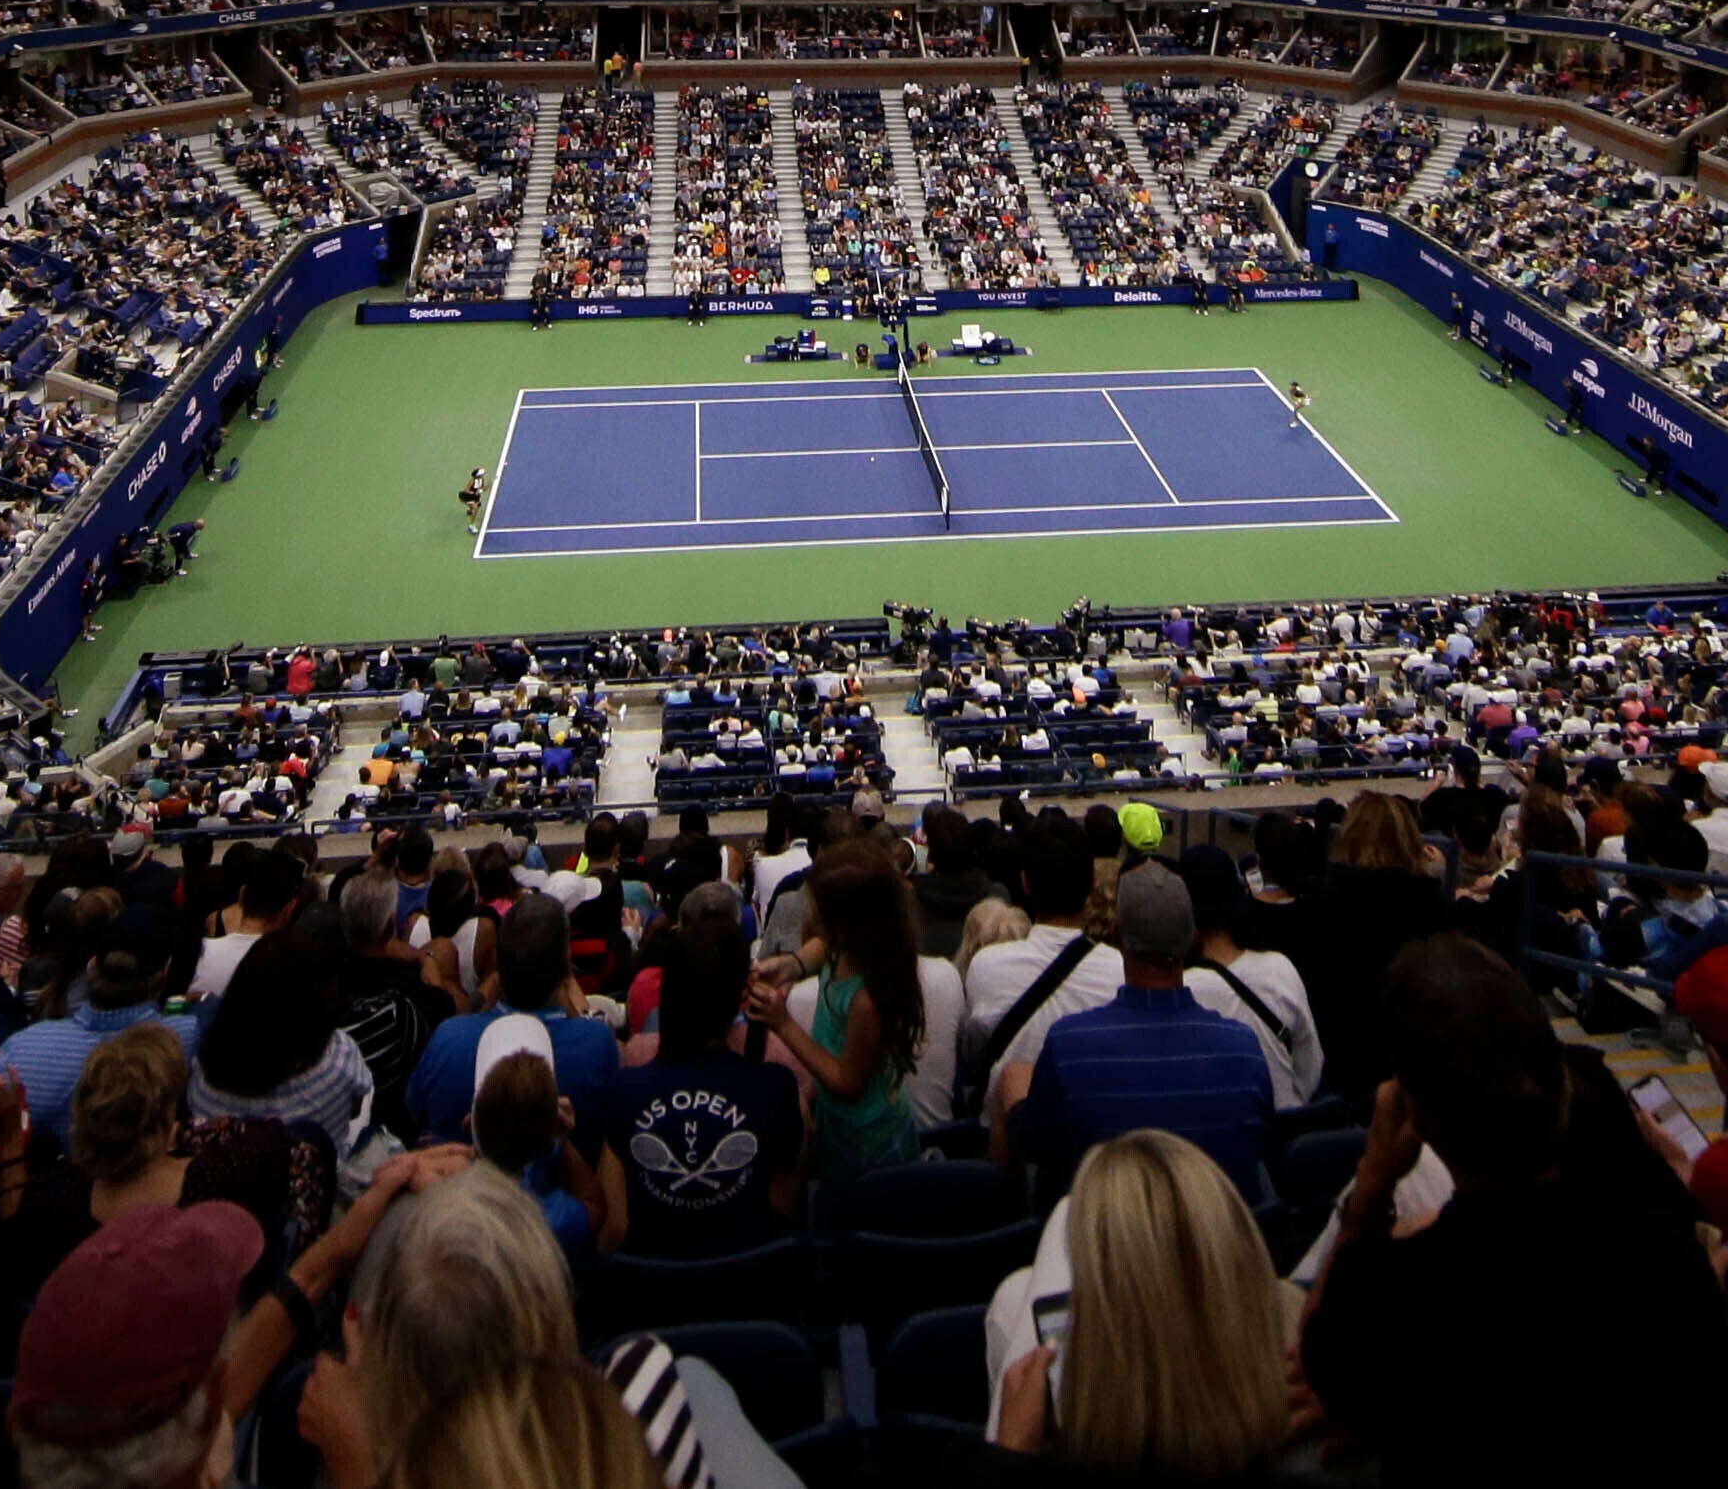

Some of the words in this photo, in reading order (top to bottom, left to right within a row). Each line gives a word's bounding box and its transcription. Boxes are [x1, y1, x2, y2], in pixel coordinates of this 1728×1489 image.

[218, 11, 256, 25] CHASE
[1355, 216, 1389, 231] AMERICAN
[1360, 223, 1389, 238] EXPRESS
[977, 292, 996, 301] YOU
[997, 292, 1027, 300] INVEST
[1114, 291, 1161, 302] Deloitte.
[1254, 287, 1323, 299] Mercedes-Benz
[409, 308, 457, 319] Spectrum
[578, 305, 598, 315] IHG
[709, 301, 774, 311] BERMUDA
[1503, 309, 1553, 355] J.P.Morgan
[213, 357, 236, 392] CHASE
[1582, 375, 1606, 399] open
[1628, 391, 1694, 449] J.P.Morgan
[128, 457, 158, 501] CHASE
[635, 1098, 667, 1130] US
[671, 1089, 747, 1128] OPEN
[684, 1120, 698, 1164] NYC
